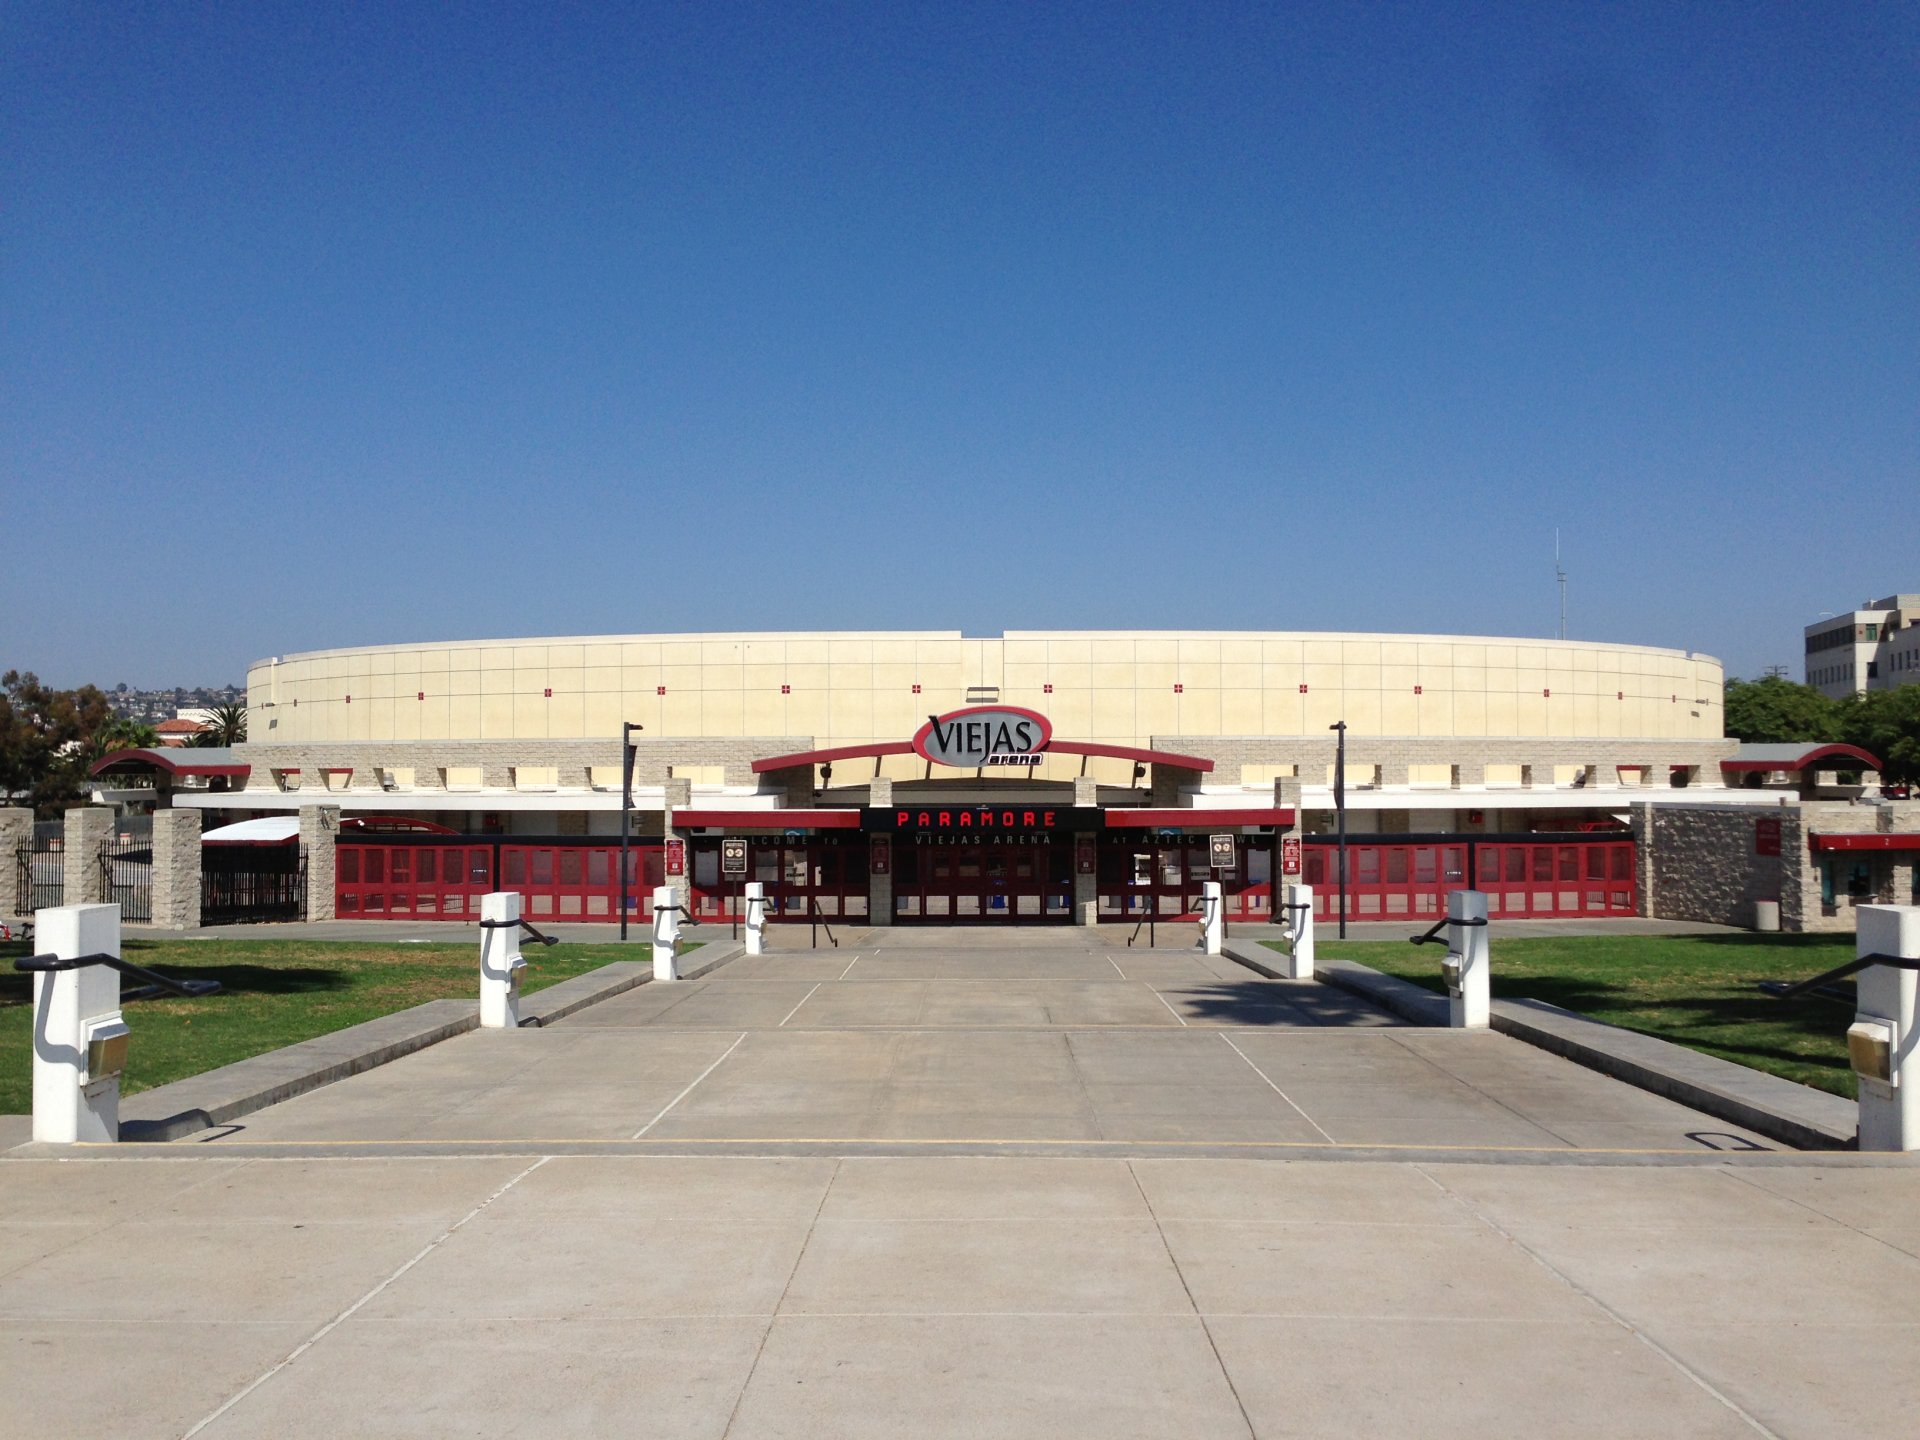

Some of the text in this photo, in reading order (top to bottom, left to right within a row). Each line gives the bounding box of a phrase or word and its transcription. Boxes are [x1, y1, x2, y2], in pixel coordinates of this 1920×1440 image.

[928, 715, 1032, 763] VIEJAS
[988, 753, 1043, 766] arena
[897, 811, 1056, 827] PARAMORE
[915, 835, 1051, 845] VIEJAS ARENA
[1142, 835, 1195, 845] AZTEC
